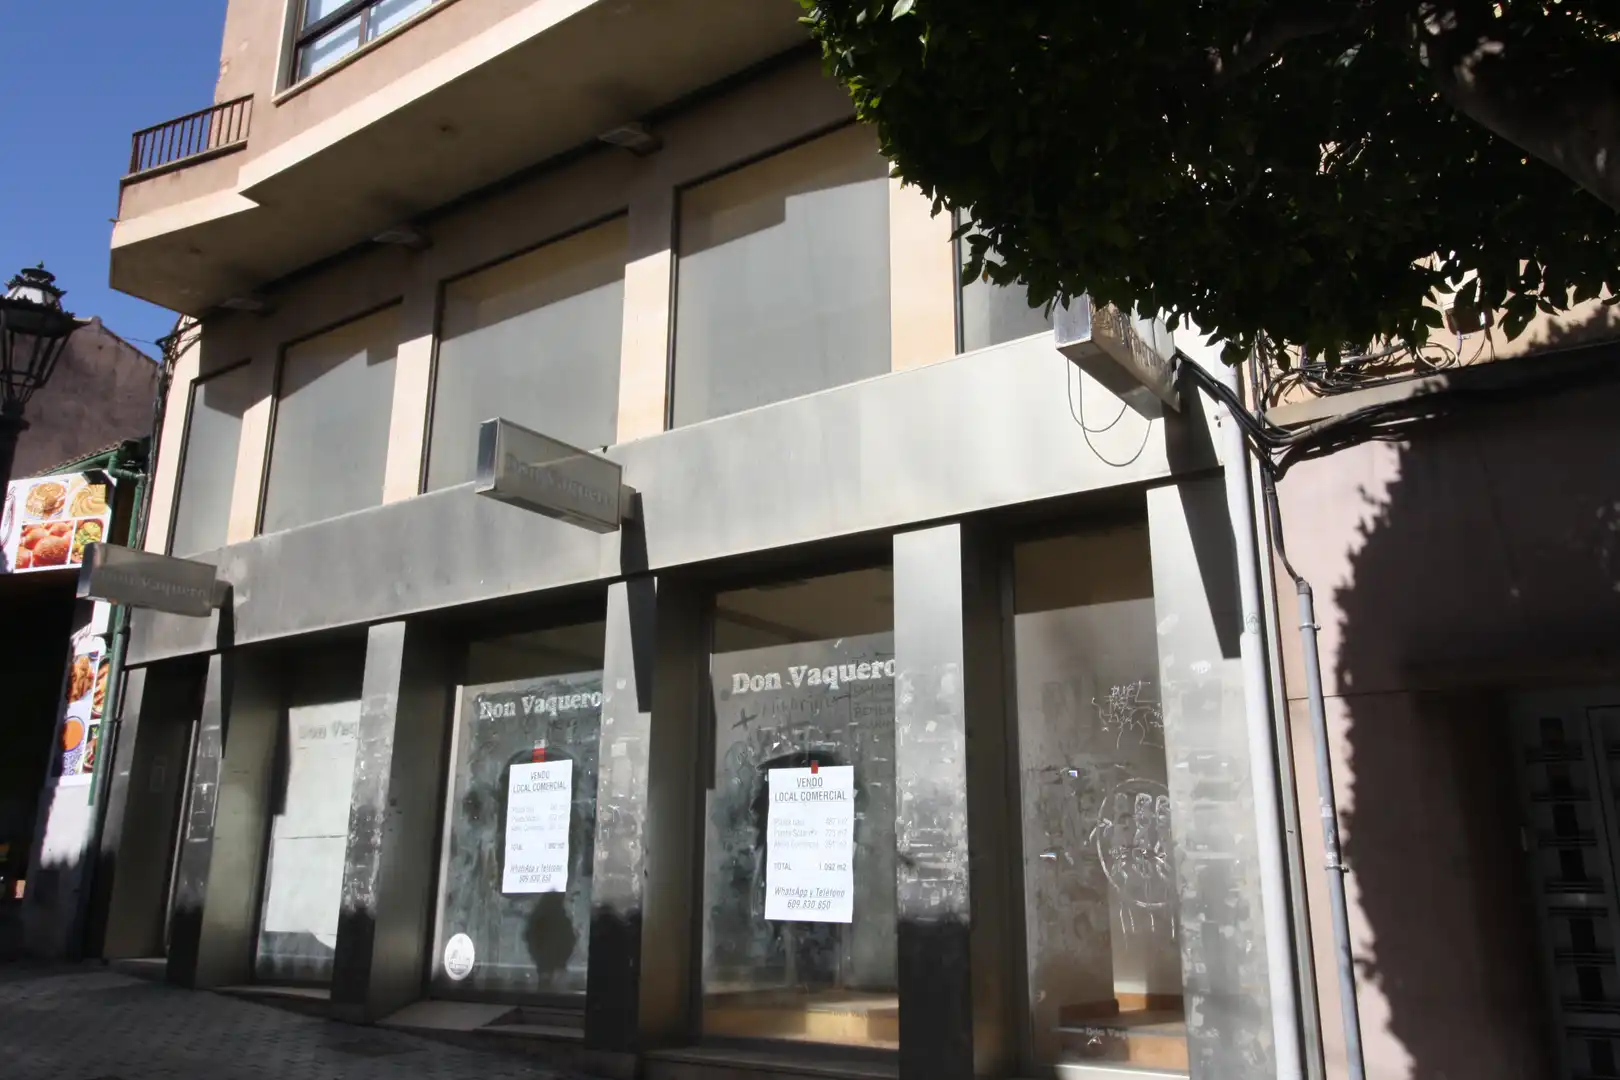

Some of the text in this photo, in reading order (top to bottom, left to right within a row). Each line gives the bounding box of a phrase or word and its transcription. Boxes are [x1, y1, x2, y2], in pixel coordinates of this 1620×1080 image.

[732, 671, 782, 695] Don
[788, 659, 896, 691] Vaquero
[479, 692, 602, 720] Don Vaquero
[531, 770, 550, 781] VENDO
[513, 781, 567, 793] LOCAL COMERCIAL
[797, 777, 823, 788] VENDO
[775, 790, 847, 802] LOCAL COMERCIAL
[774, 862, 792, 871] TOTAL
[837, 863, 847, 871] m2
[774, 887, 808, 898] WhatsApp
[787, 900, 801, 909] 609
